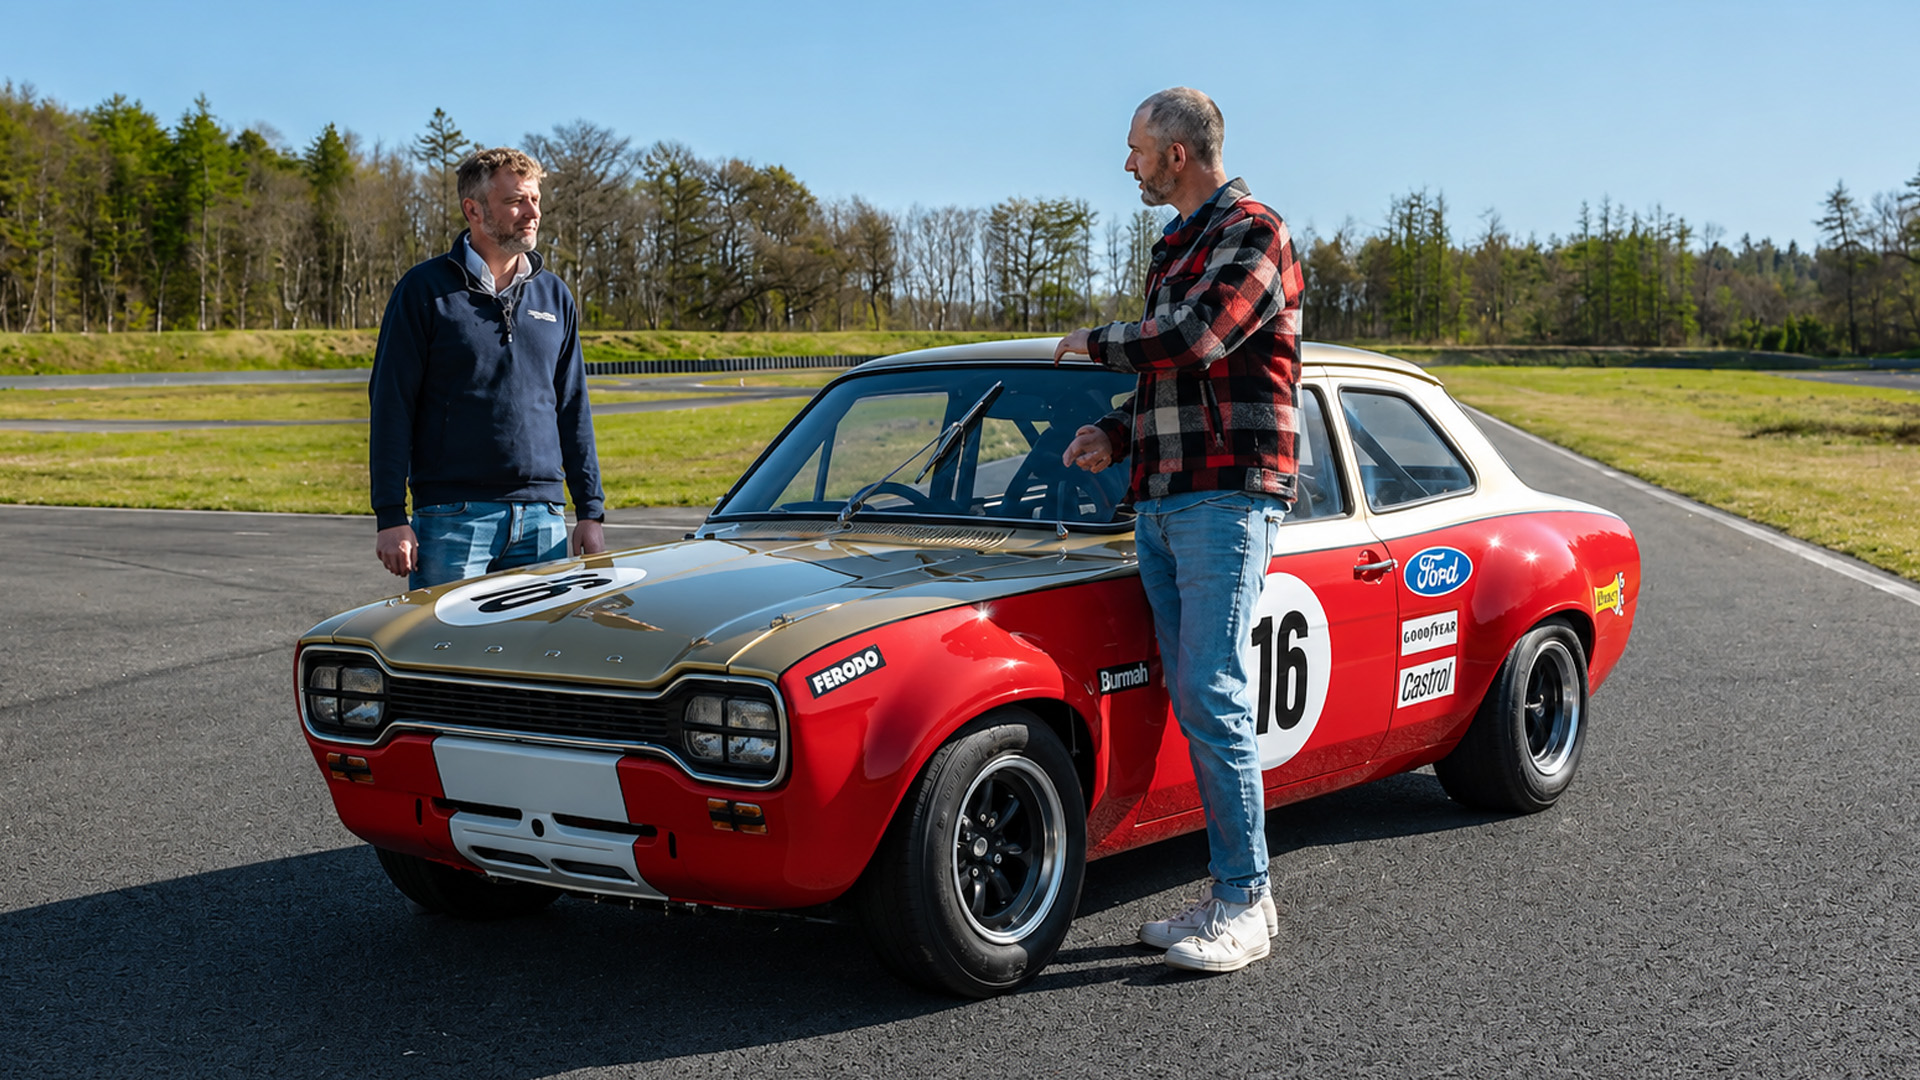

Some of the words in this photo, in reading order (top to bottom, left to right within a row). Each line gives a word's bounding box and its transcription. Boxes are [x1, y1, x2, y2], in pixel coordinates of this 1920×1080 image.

[1417, 552, 1459, 589] Ford
[1403, 621, 1456, 643] GOODYEAR
[812, 650, 879, 694] FERODO
[1100, 662, 1148, 692] Burmah
[1251, 610, 1308, 735] 16
[1402, 661, 1453, 701] Castrol
